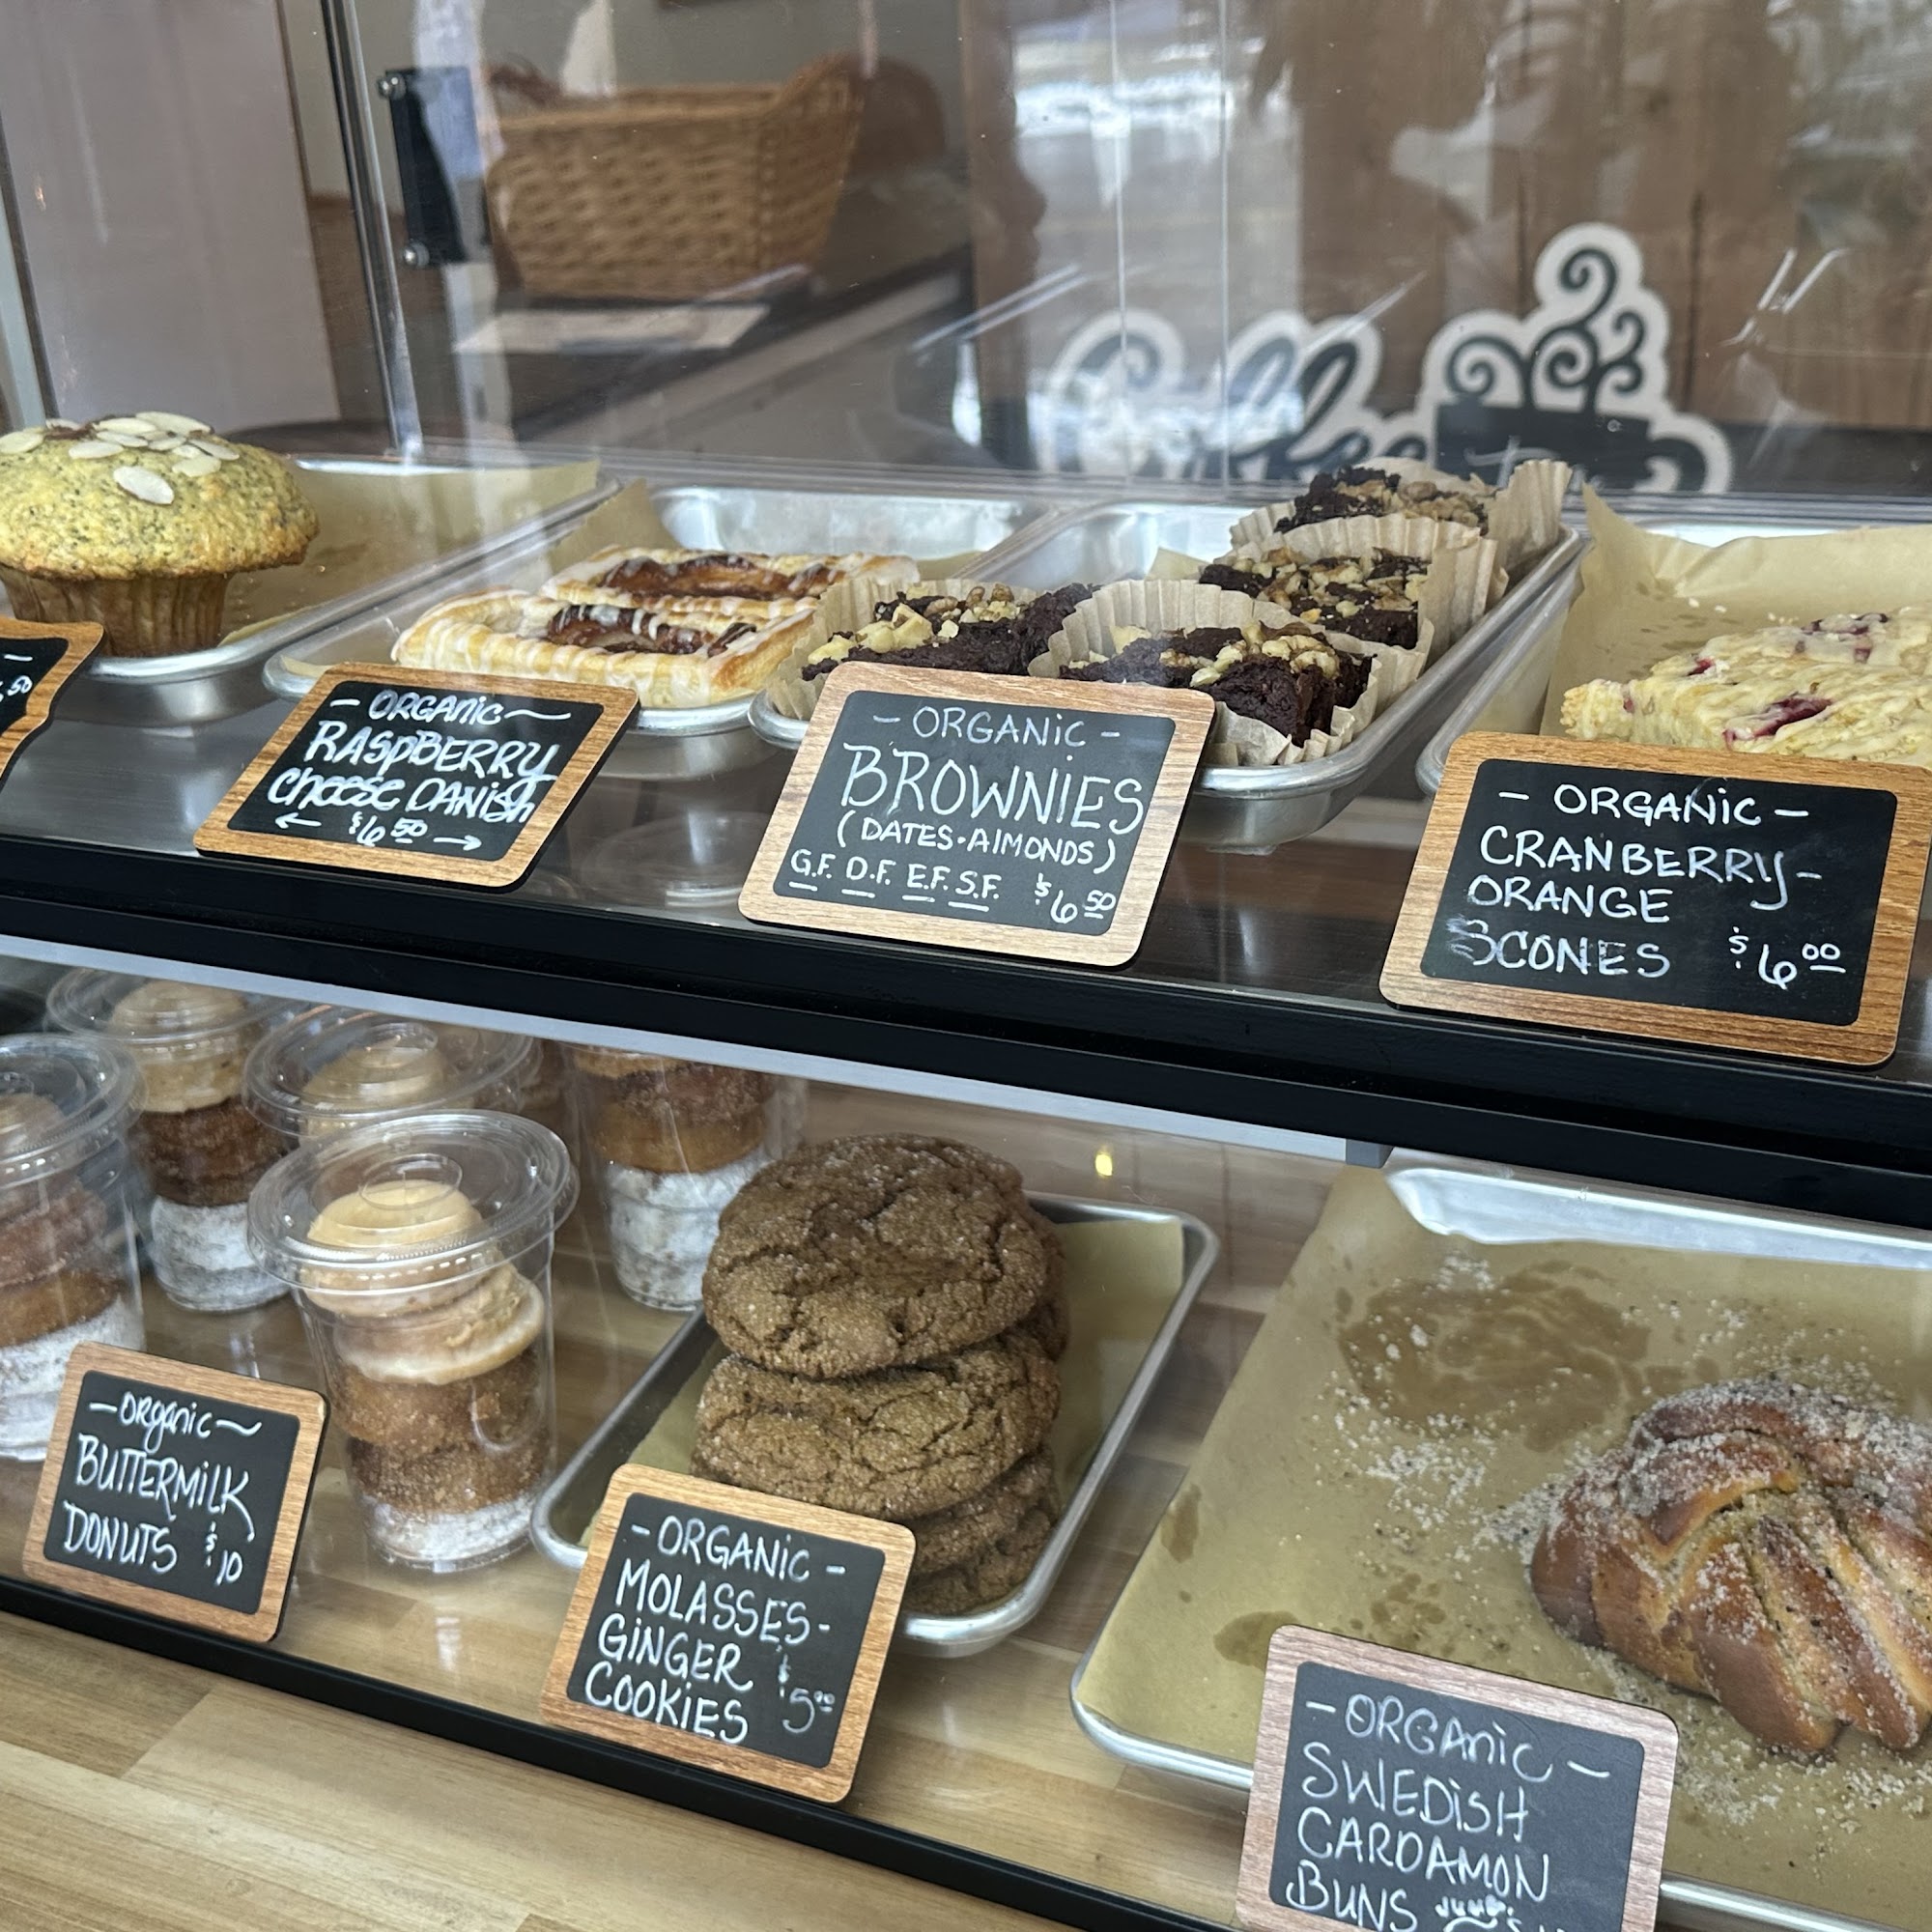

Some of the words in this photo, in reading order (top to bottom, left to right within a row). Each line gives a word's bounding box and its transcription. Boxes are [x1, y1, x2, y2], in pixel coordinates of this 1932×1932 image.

[303, 720, 560, 781] RASPBERRY
[841, 741, 1145, 836] BROWNIES
[1466, 874, 1674, 923] ORANGE
[1448, 919, 1671, 979] SCONES
[75, 1433, 255, 1543] BUTTERMILK
[63, 1499, 178, 1574] DONUTS
[205, 1520, 242, 1586] $10
[598, 1612, 753, 1691] GINGER
[584, 1661, 748, 1745] COOKIES
[1302, 1742, 1529, 1842] SWEDISH
[1286, 1860, 1418, 1932] BUNS
[1297, 1806, 1550, 1902] CARDAMON
